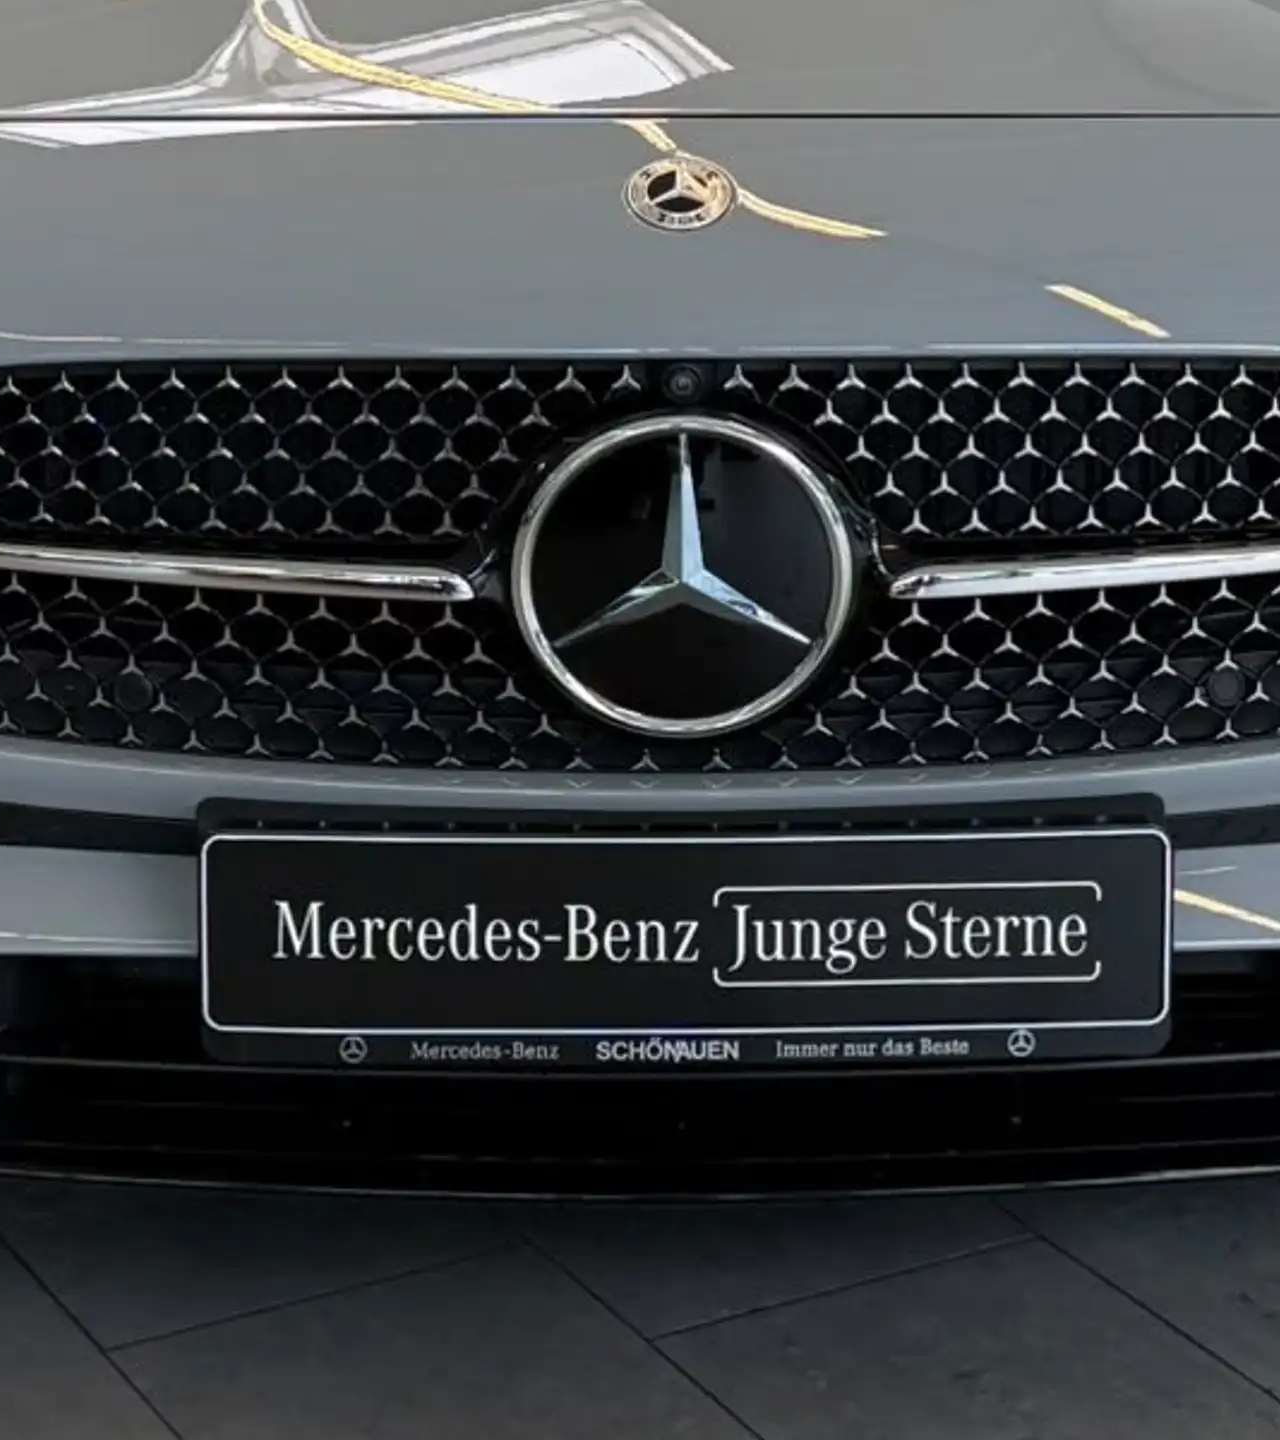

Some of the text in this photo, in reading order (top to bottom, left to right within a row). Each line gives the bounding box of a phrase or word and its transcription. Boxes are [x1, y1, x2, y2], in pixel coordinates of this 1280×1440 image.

[273, 899, 1089, 975] Mercedes-Benz Junge Sterne
[410, 1040, 560, 1061] Mercedes-Benz
[775, 1039, 841, 1059] Immer
[843, 1041, 878, 1058] nur
[881, 1037, 915, 1058] das
